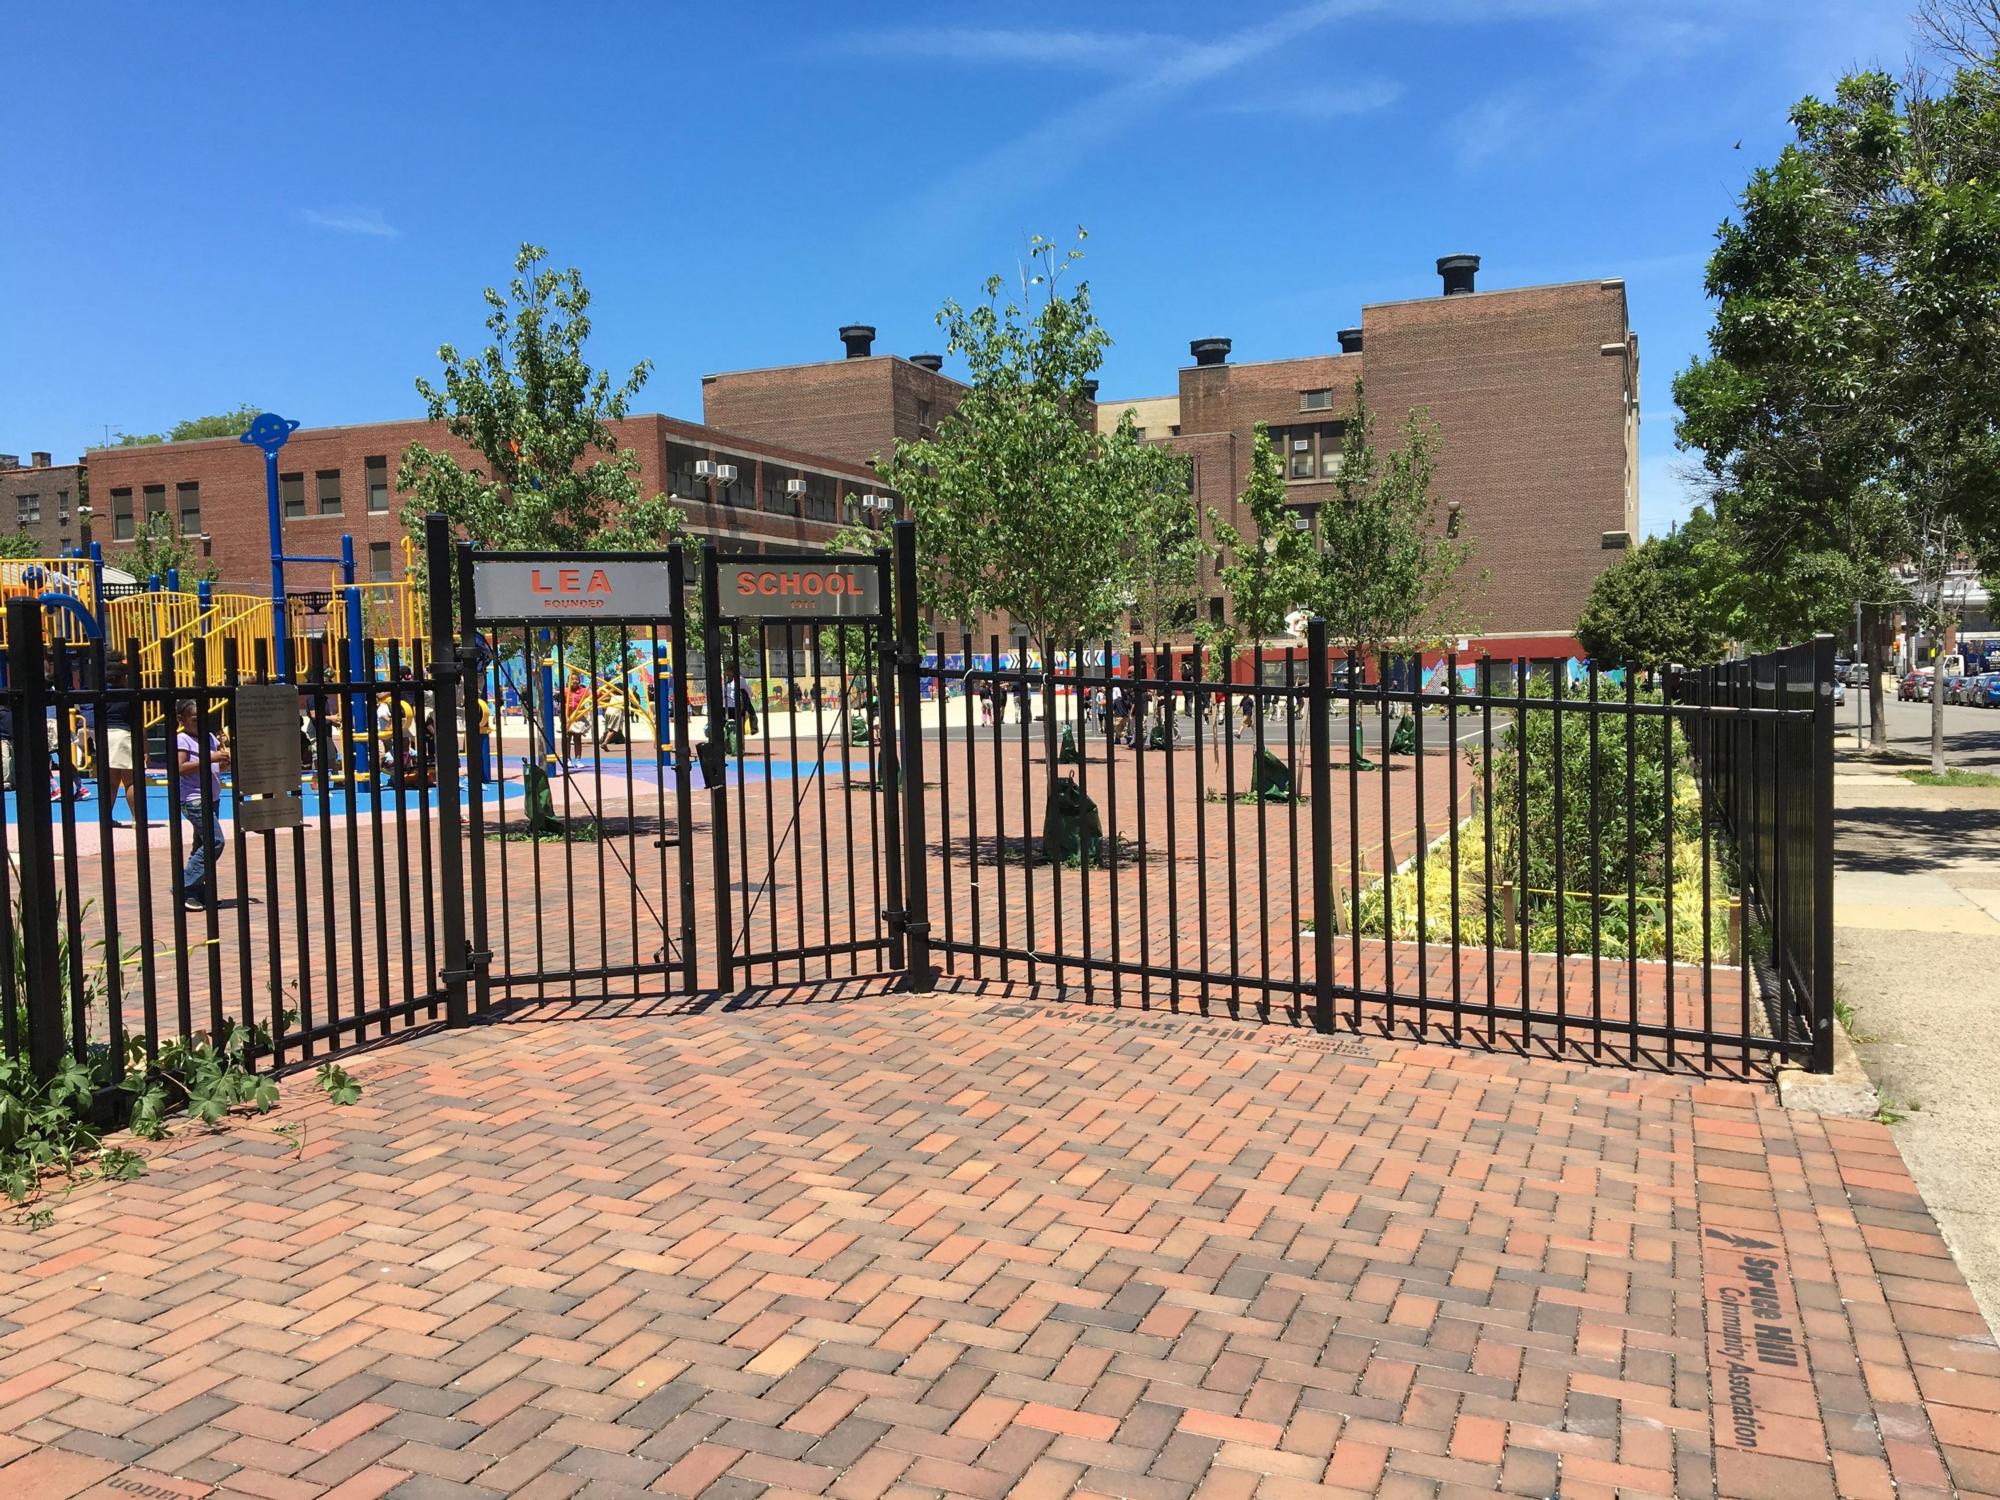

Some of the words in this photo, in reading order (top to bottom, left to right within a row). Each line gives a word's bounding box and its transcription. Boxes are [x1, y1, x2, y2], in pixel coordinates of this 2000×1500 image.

[531, 570, 613, 594] LEA
[736, 572, 864, 596] SCHOOL
[544, 599, 605, 609] FOUNDED
[1045, 1010, 1177, 1031] Walnut
[1190, 1025, 1257, 1041] Hill
[1738, 1256, 1782, 1320] Spruce
[1716, 1287, 1745, 1361] Community
[1755, 1324, 1798, 1367] Hill
[1727, 1361, 1766, 1448] Association
